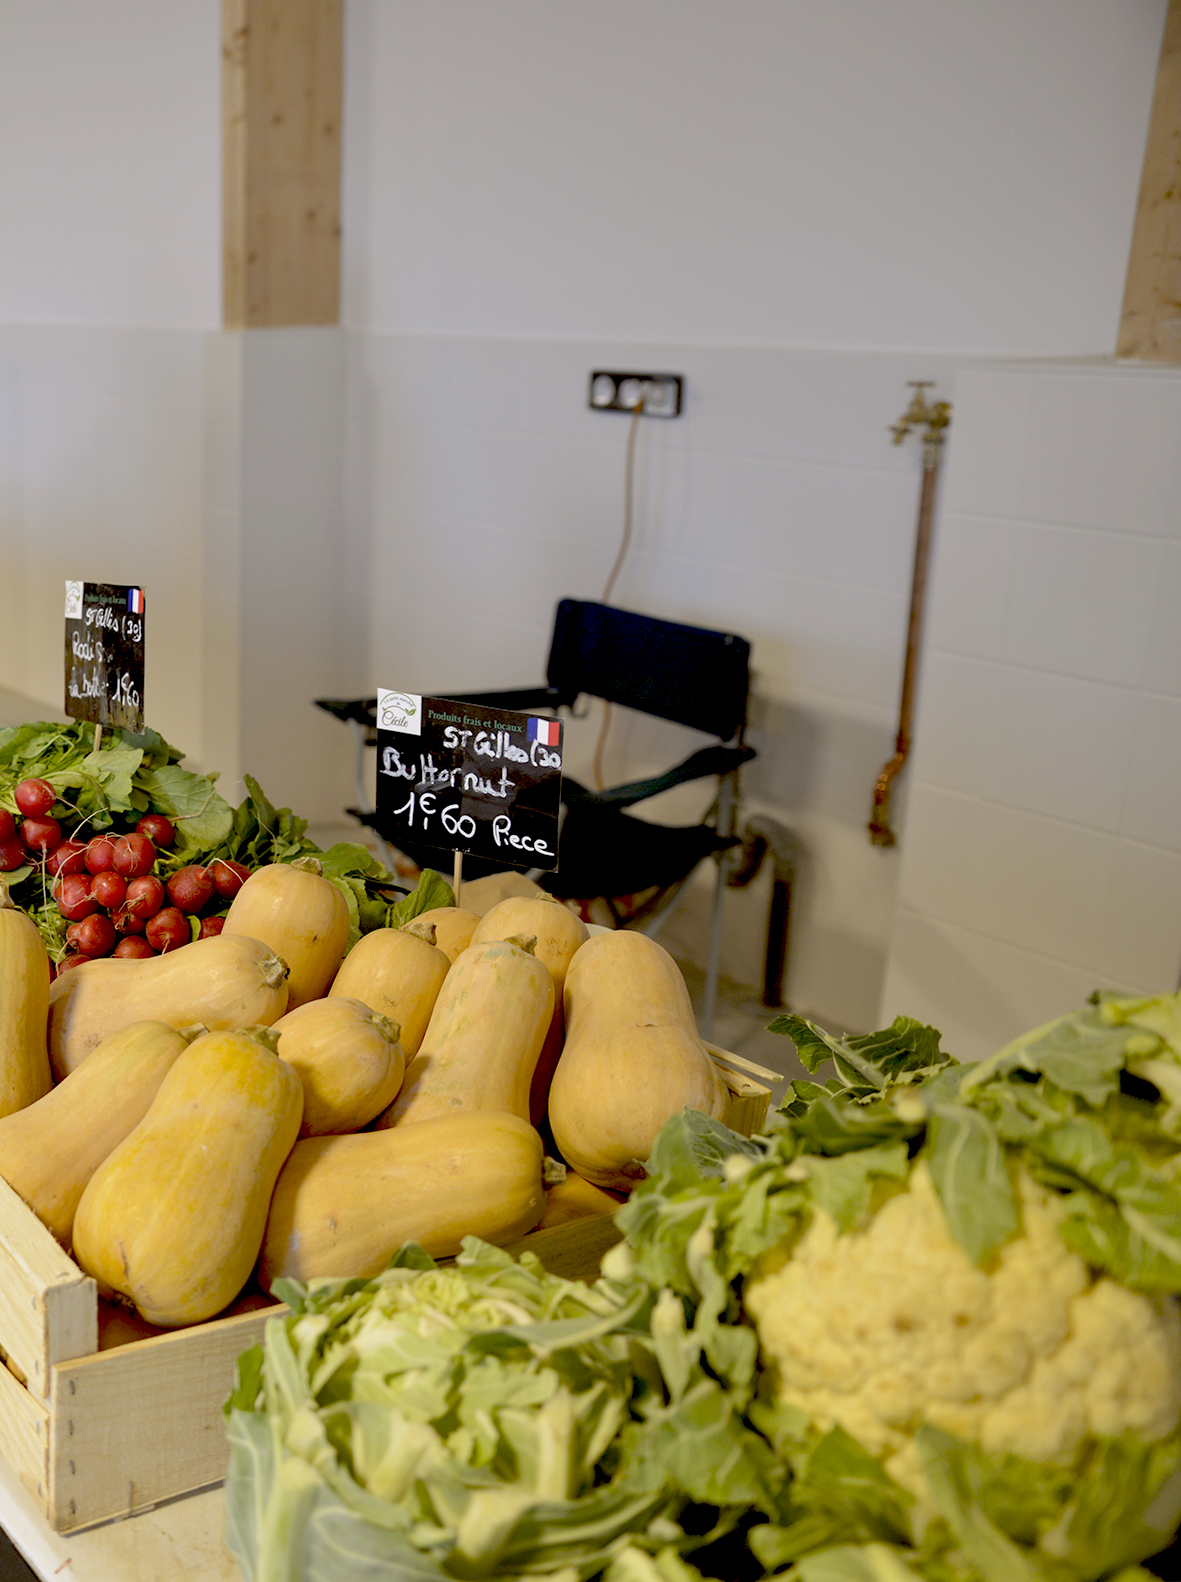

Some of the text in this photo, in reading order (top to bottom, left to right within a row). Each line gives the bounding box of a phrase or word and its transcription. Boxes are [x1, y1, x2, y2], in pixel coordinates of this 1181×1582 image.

[381, 710, 409, 728] Cécile
[428, 710, 522, 732] Produits frais et locaux
